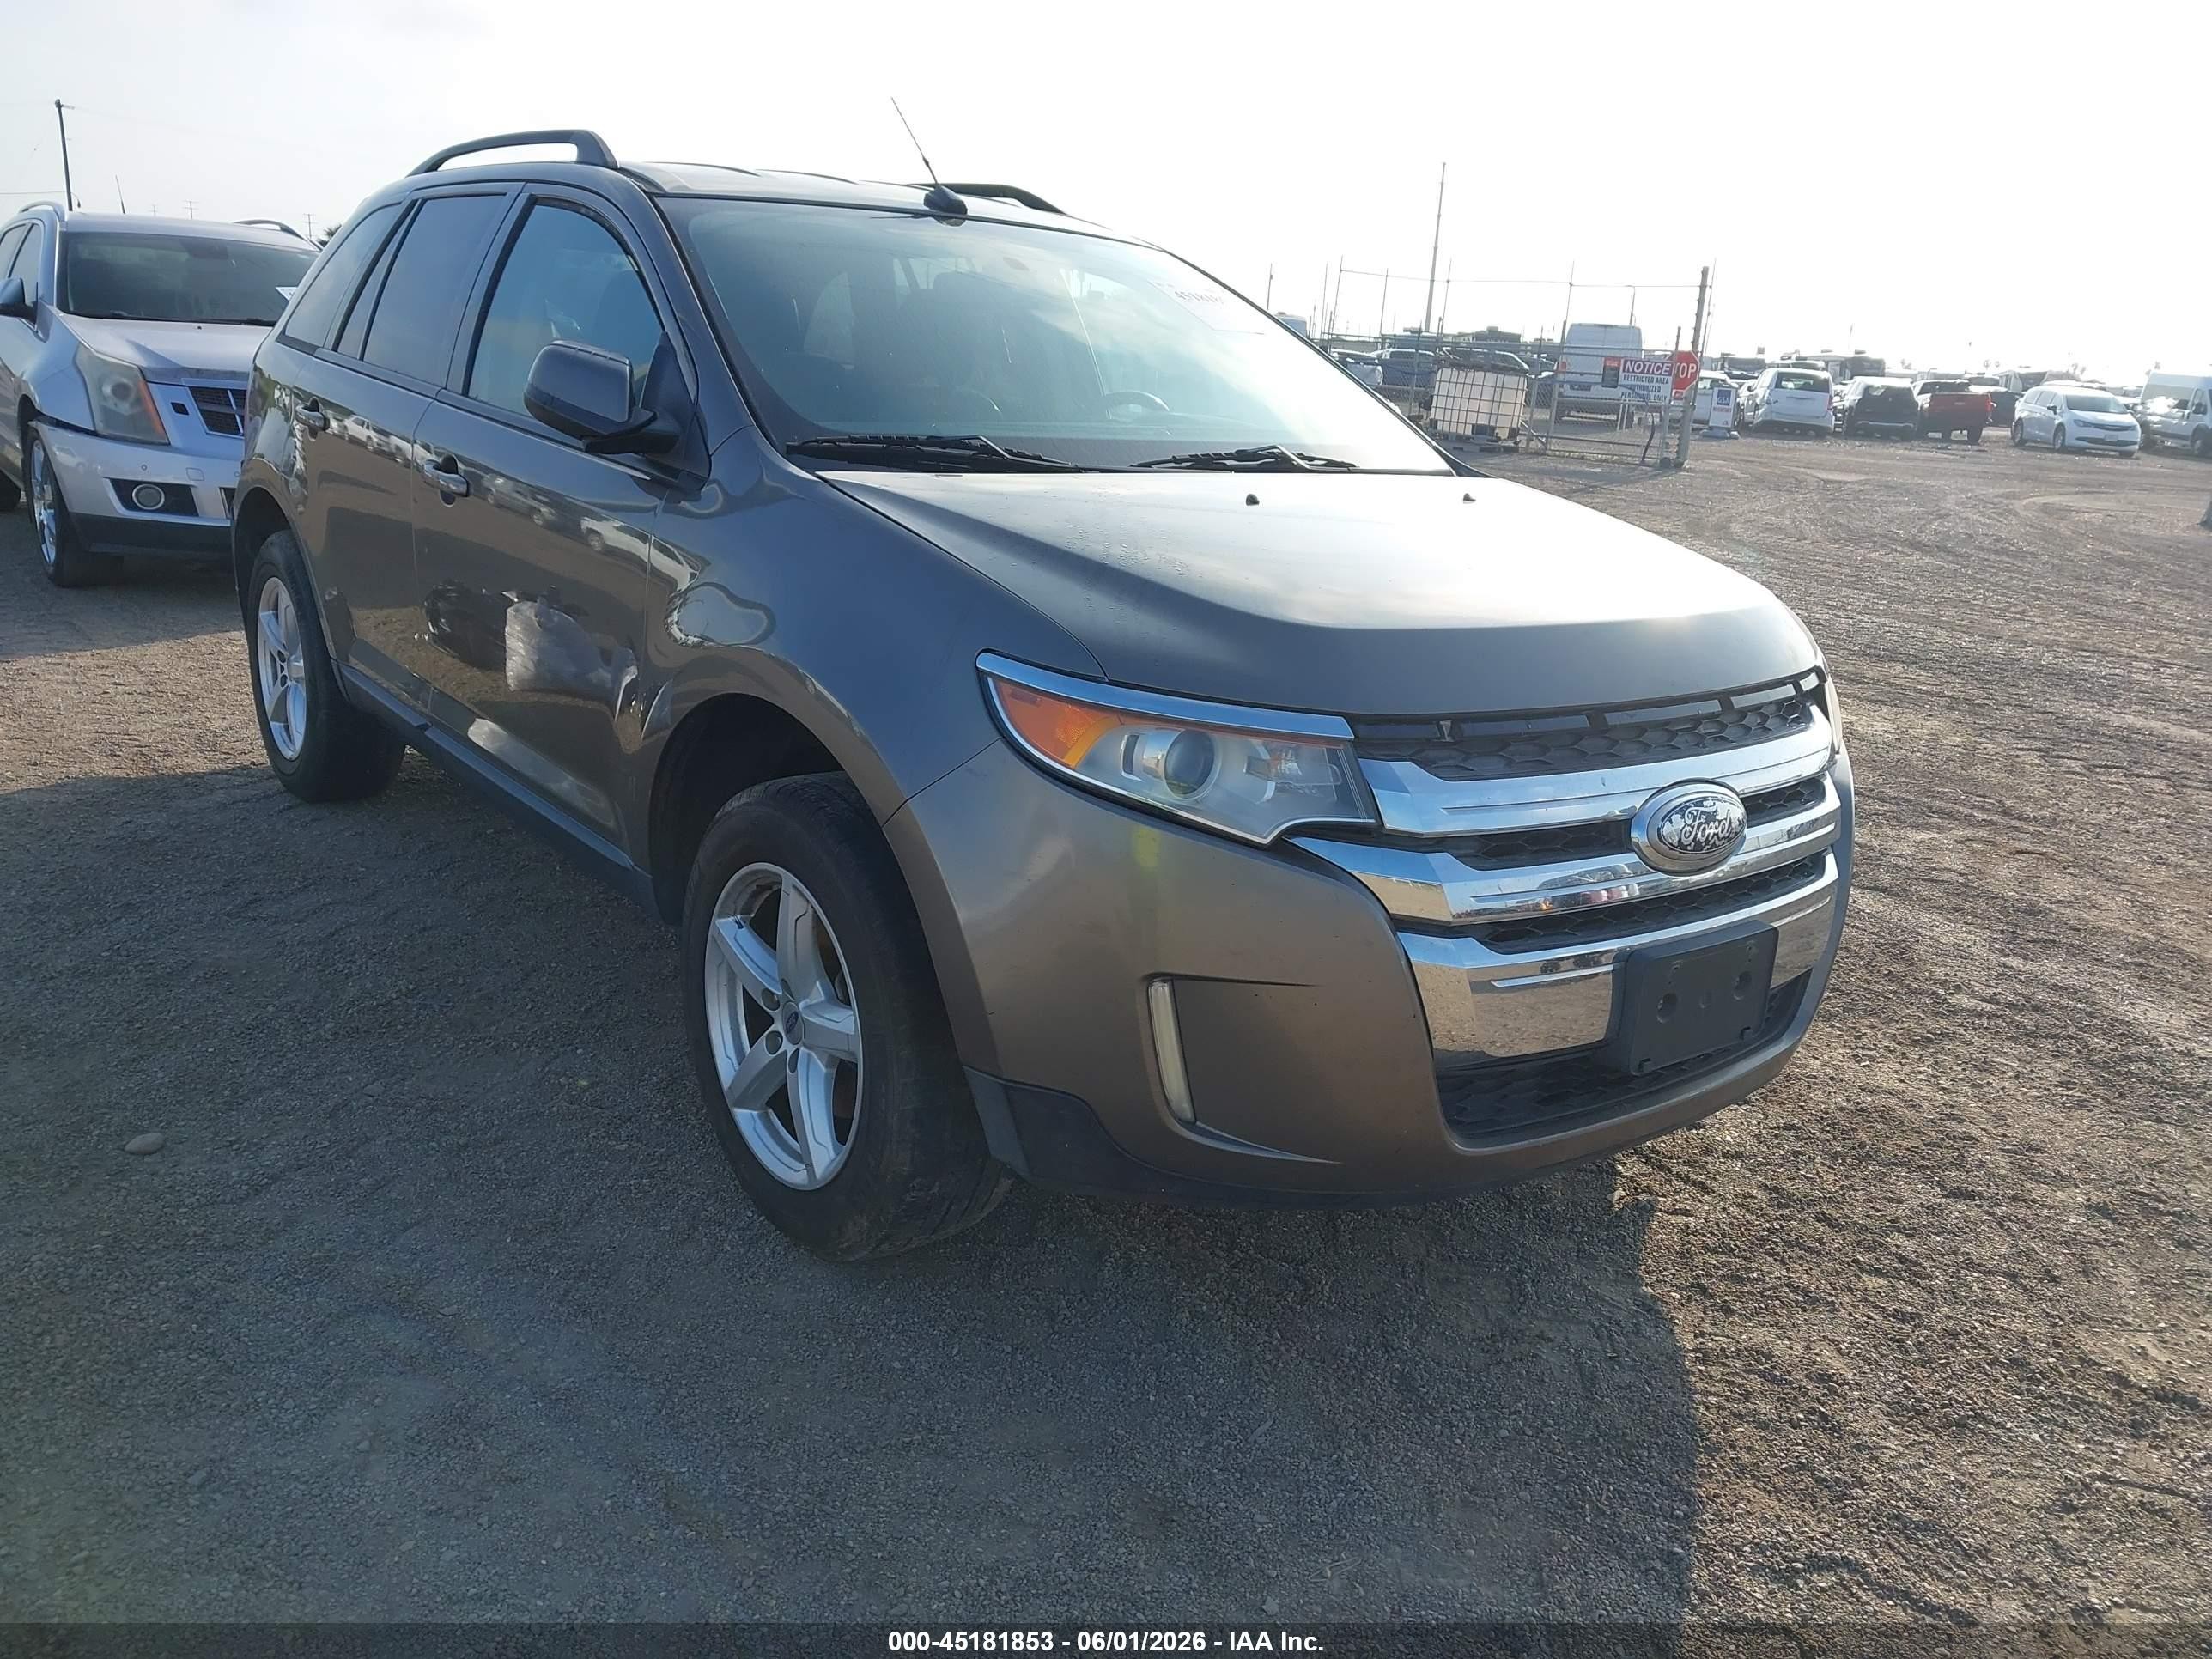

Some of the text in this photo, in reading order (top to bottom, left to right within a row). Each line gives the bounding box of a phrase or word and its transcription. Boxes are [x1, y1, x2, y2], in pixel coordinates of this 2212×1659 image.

[1625, 360, 1671, 375] NOTICE
[1624, 374, 1654, 384] RESTRICTED
[1680, 800, 1731, 845] Ford
